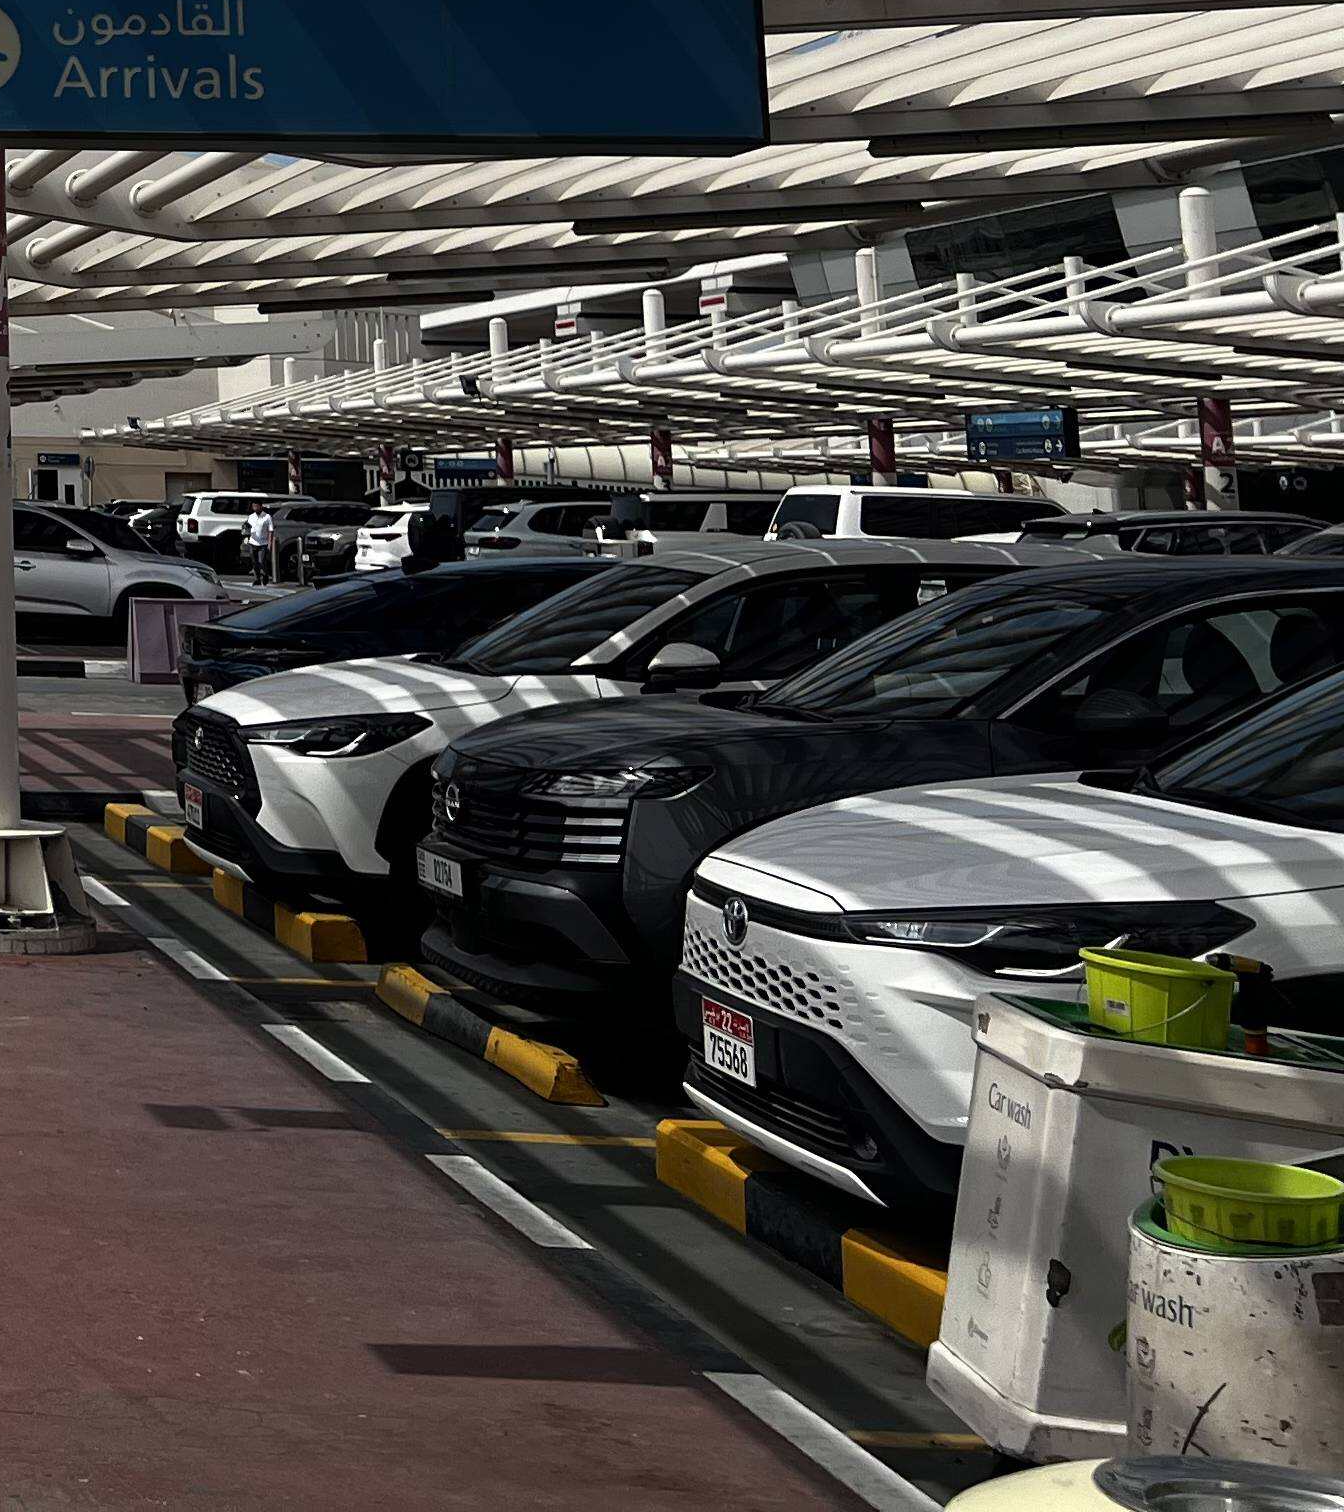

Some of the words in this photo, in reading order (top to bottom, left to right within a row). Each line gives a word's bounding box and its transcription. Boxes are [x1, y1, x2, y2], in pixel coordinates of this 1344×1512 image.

[53, 54, 266, 101] Arrivals
[1220, 472, 1235, 494] 2
[710, 1031, 748, 1078] 75568
[988, 1082, 1006, 1114] Car
[1141, 1287, 1194, 1329] wash
